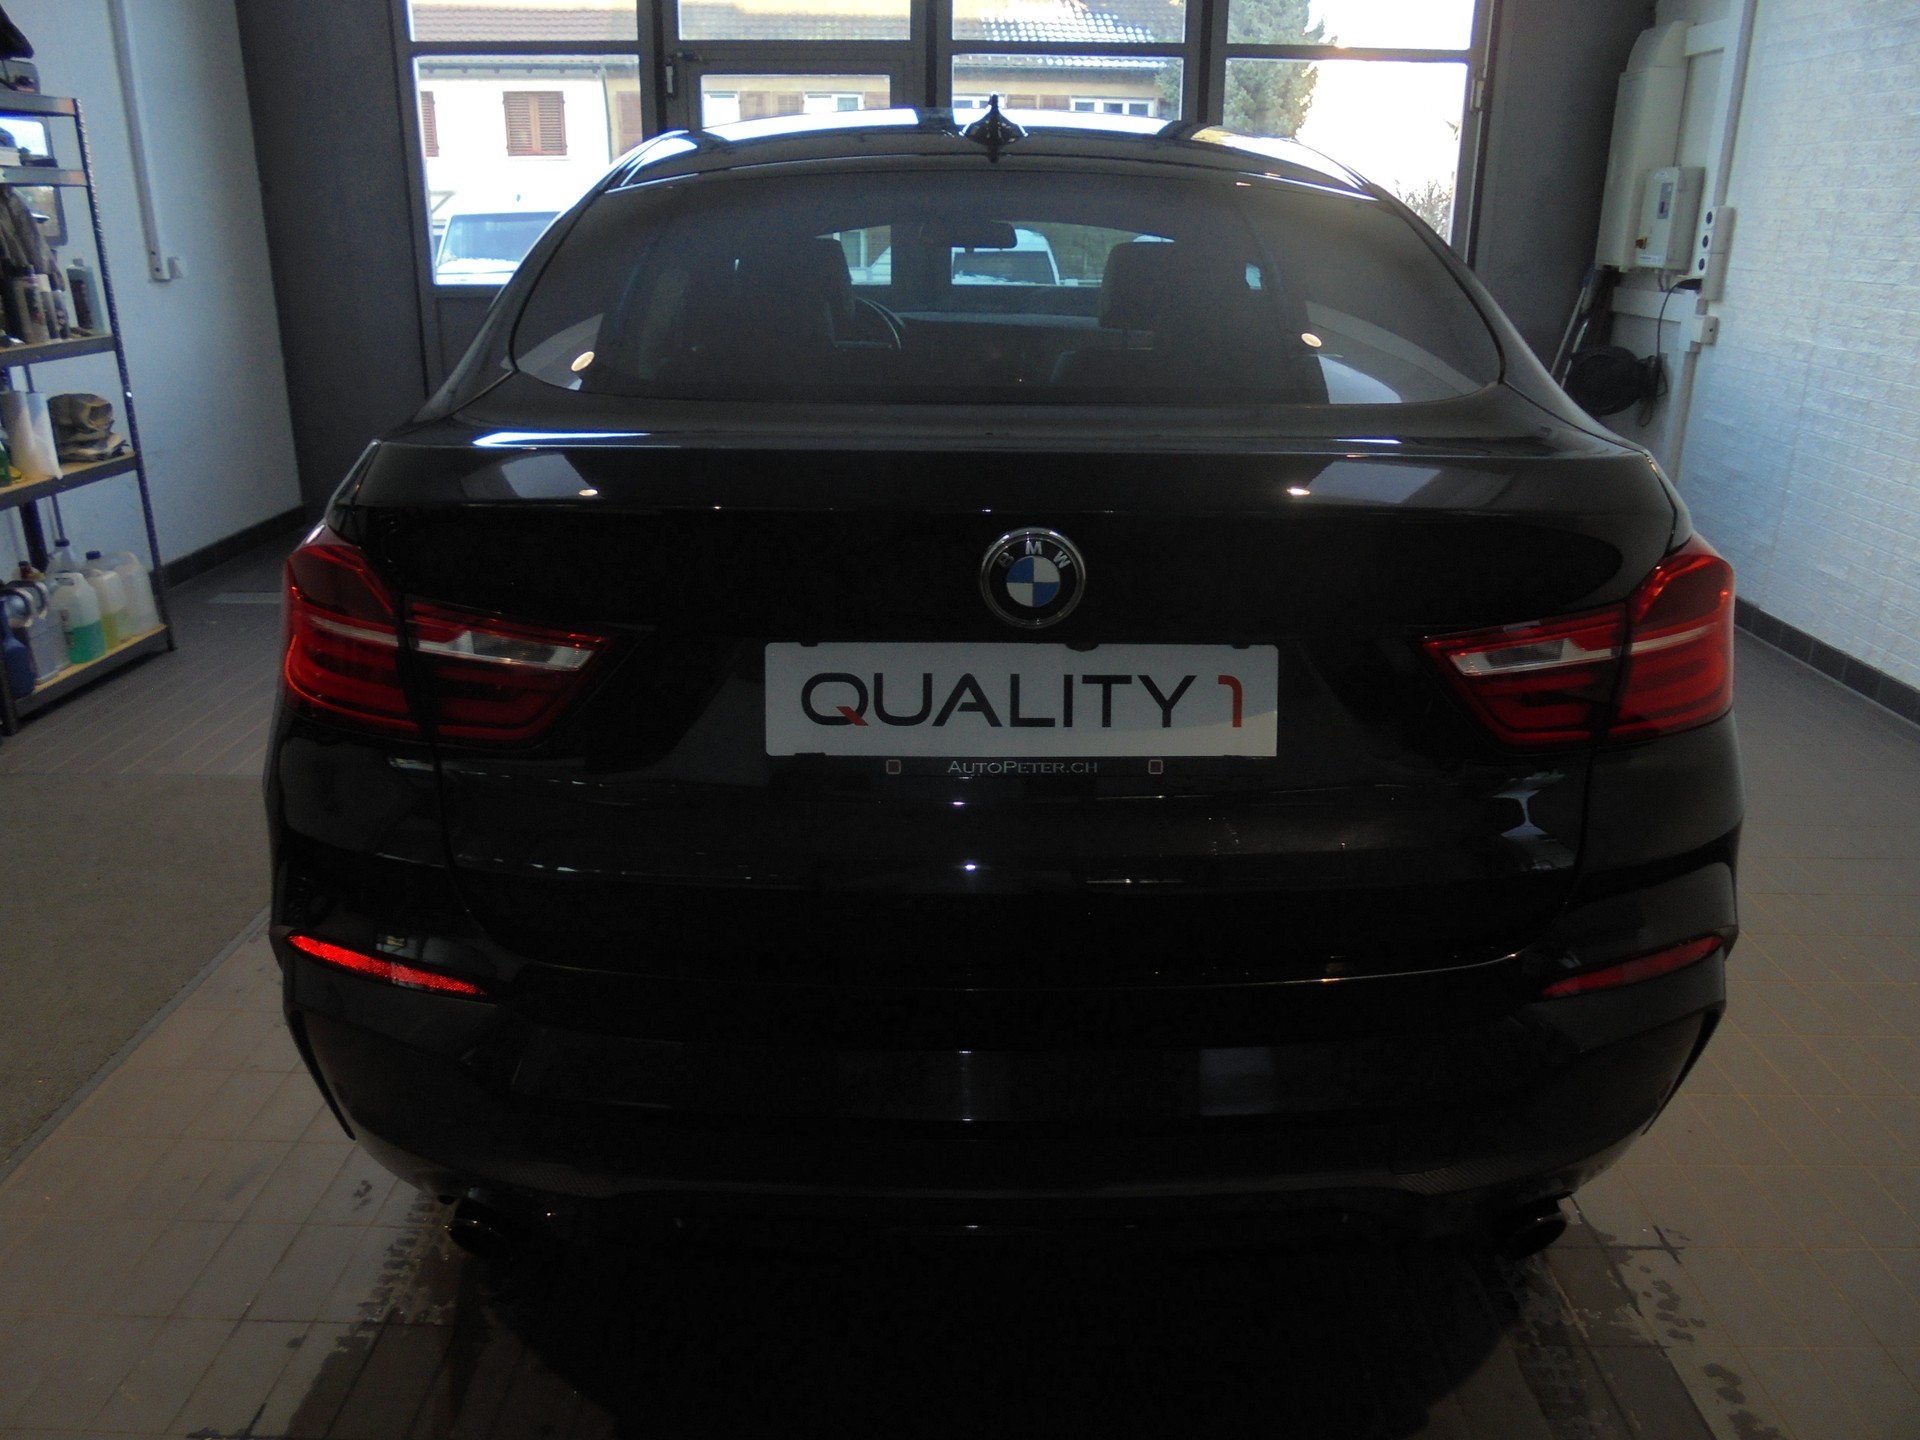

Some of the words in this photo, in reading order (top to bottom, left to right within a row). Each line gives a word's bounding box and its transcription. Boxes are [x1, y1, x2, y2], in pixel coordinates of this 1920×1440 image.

[996, 540, 1072, 569] BMW
[801, 672, 1197, 728] QUALITY
[1217, 674, 1243, 728] 1
